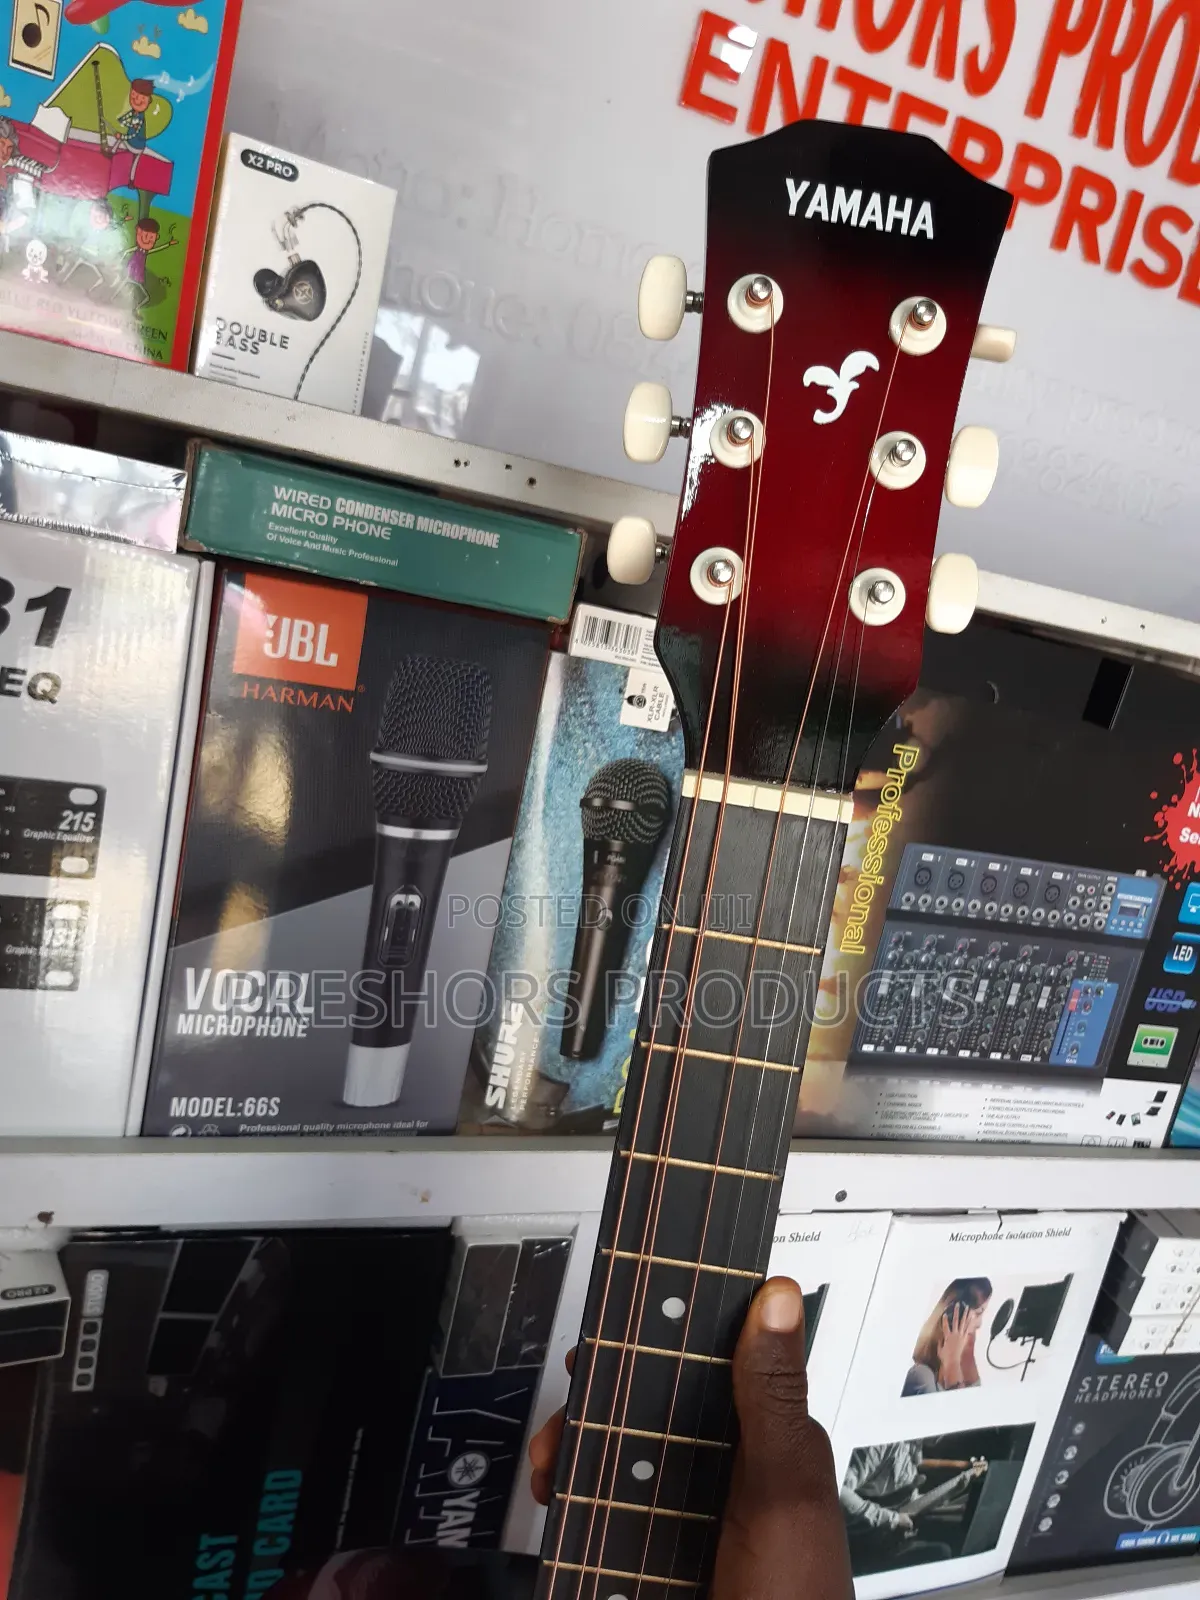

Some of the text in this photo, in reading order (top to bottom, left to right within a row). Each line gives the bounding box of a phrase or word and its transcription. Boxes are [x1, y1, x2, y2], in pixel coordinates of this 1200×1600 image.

[247, 153, 293, 178] X2 PRO
[785, 178, 935, 240] YAMAHA
[214, 331, 261, 356] BASS
[215, 316, 290, 351] DOUBLE
[268, 521, 339, 545] Excellent Quality
[271, 502, 393, 541] MICRO PHONE
[273, 486, 501, 550] WIRED CONDENSER MICROPHONE
[266, 532, 399, 567] Of Voice And Music Professional
[263, 613, 339, 667] JBL
[0, 665, 62, 704] EQ
[241, 681, 354, 713] HARMAN
[646, 685, 660, 723] XLR-XLR
[653, 691, 665, 721] CABLE
[23, 828, 96, 844] Graphic Equalizer
[58, 809, 97, 833] 215
[839, 743, 920, 955] Professional
[1172, 943, 1193, 963] LED
[186, 967, 315, 1015] VOCAL
[177, 1013, 311, 1039] MICROPHONE
[485, 999, 525, 1110] SHURE
[509, 1050, 527, 1110] LEGENDARY
[519, 1033, 541, 1111] PERFORMANCE
[170, 1096, 281, 1118] MODEL:66S
[239, 1119, 429, 1132] Professional quality microphone ideal for
[788, 1230, 821, 1243] Shield
[949, 1226, 1072, 1243] Microphone Isolation Shield
[1074, 1386, 1163, 1404] HEADPHONES
[1078, 1370, 1170, 1394] STEREO
[252, 1468, 303, 1557] CARD
[190, 1533, 238, 1600] AST
